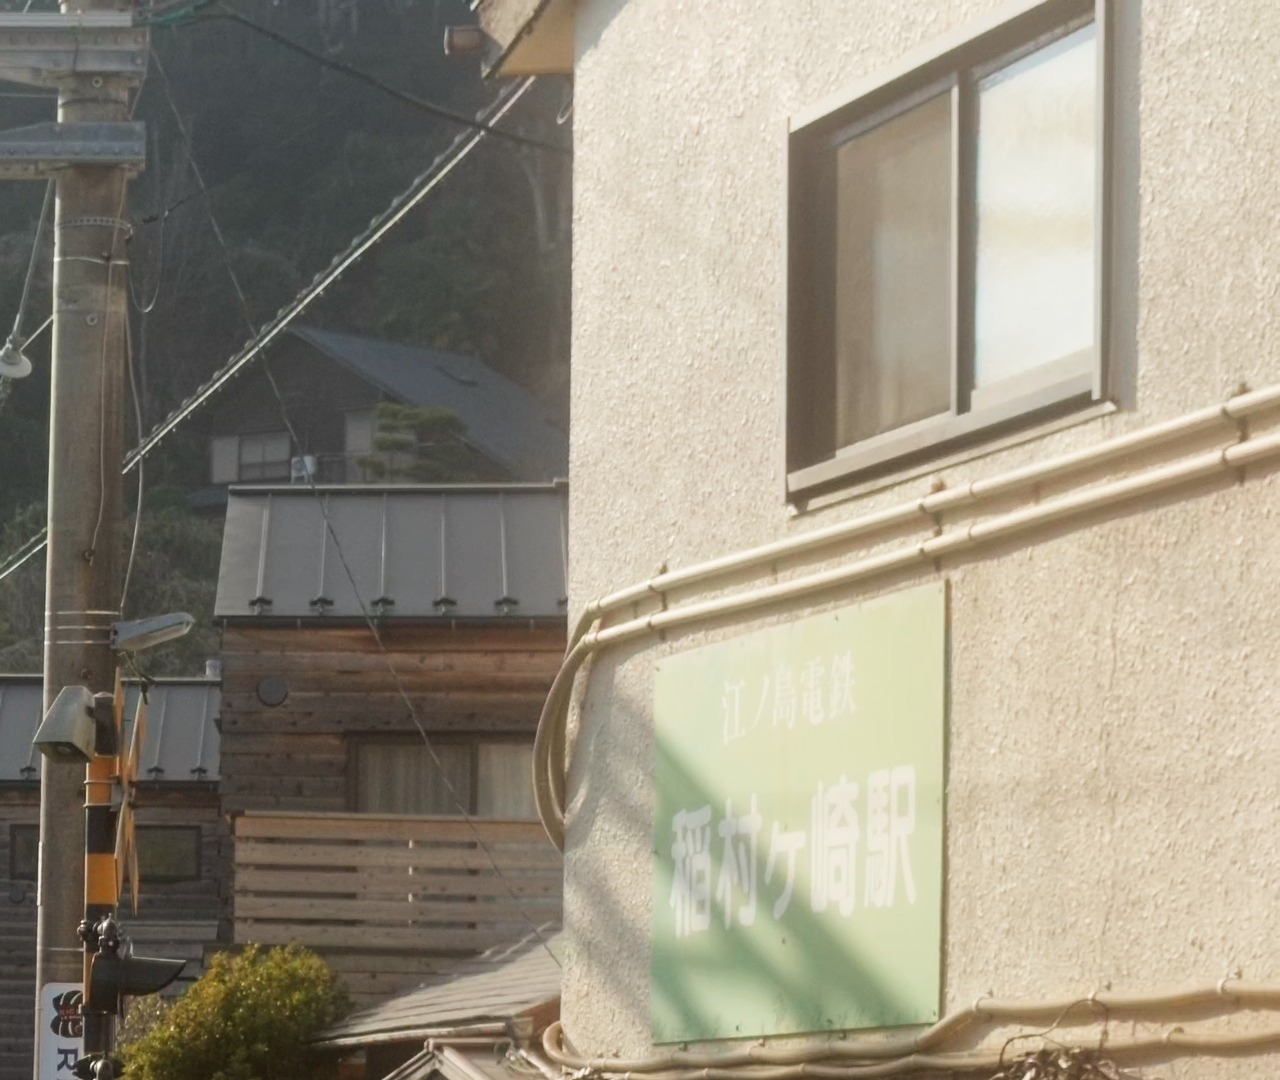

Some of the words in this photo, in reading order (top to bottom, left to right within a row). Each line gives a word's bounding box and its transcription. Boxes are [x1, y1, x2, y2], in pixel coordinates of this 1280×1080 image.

[720, 649, 856, 745] 江ノ島電鉄
